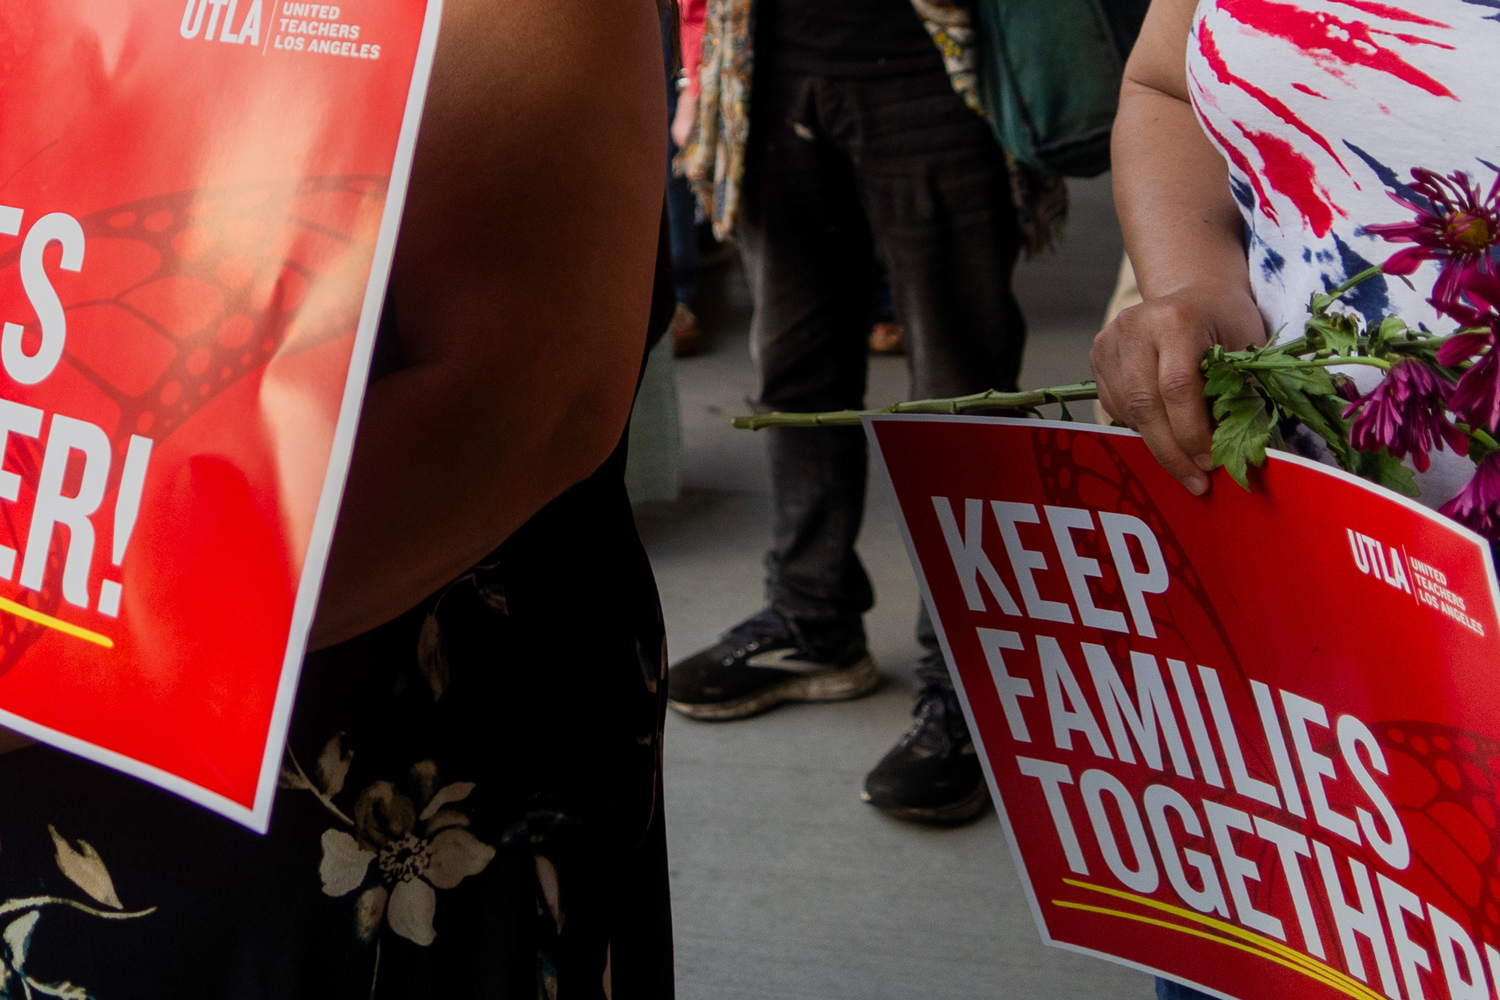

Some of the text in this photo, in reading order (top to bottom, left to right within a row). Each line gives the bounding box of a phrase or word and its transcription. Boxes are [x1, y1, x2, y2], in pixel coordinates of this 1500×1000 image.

[279, 18, 360, 40] TEACHERS
[282, 2, 340, 20] UNITED
[274, 35, 381, 59] LOS ANGELES
[930, 496, 1169, 638] KEEP
[1346, 528, 1412, 595] UTLA
[1410, 556, 1448, 586] UNITED
[1414, 572, 1467, 611] TEACHERS
[1418, 588, 1485, 637] LOS ANGELES
[975, 627, 1409, 870] FAMILIES
